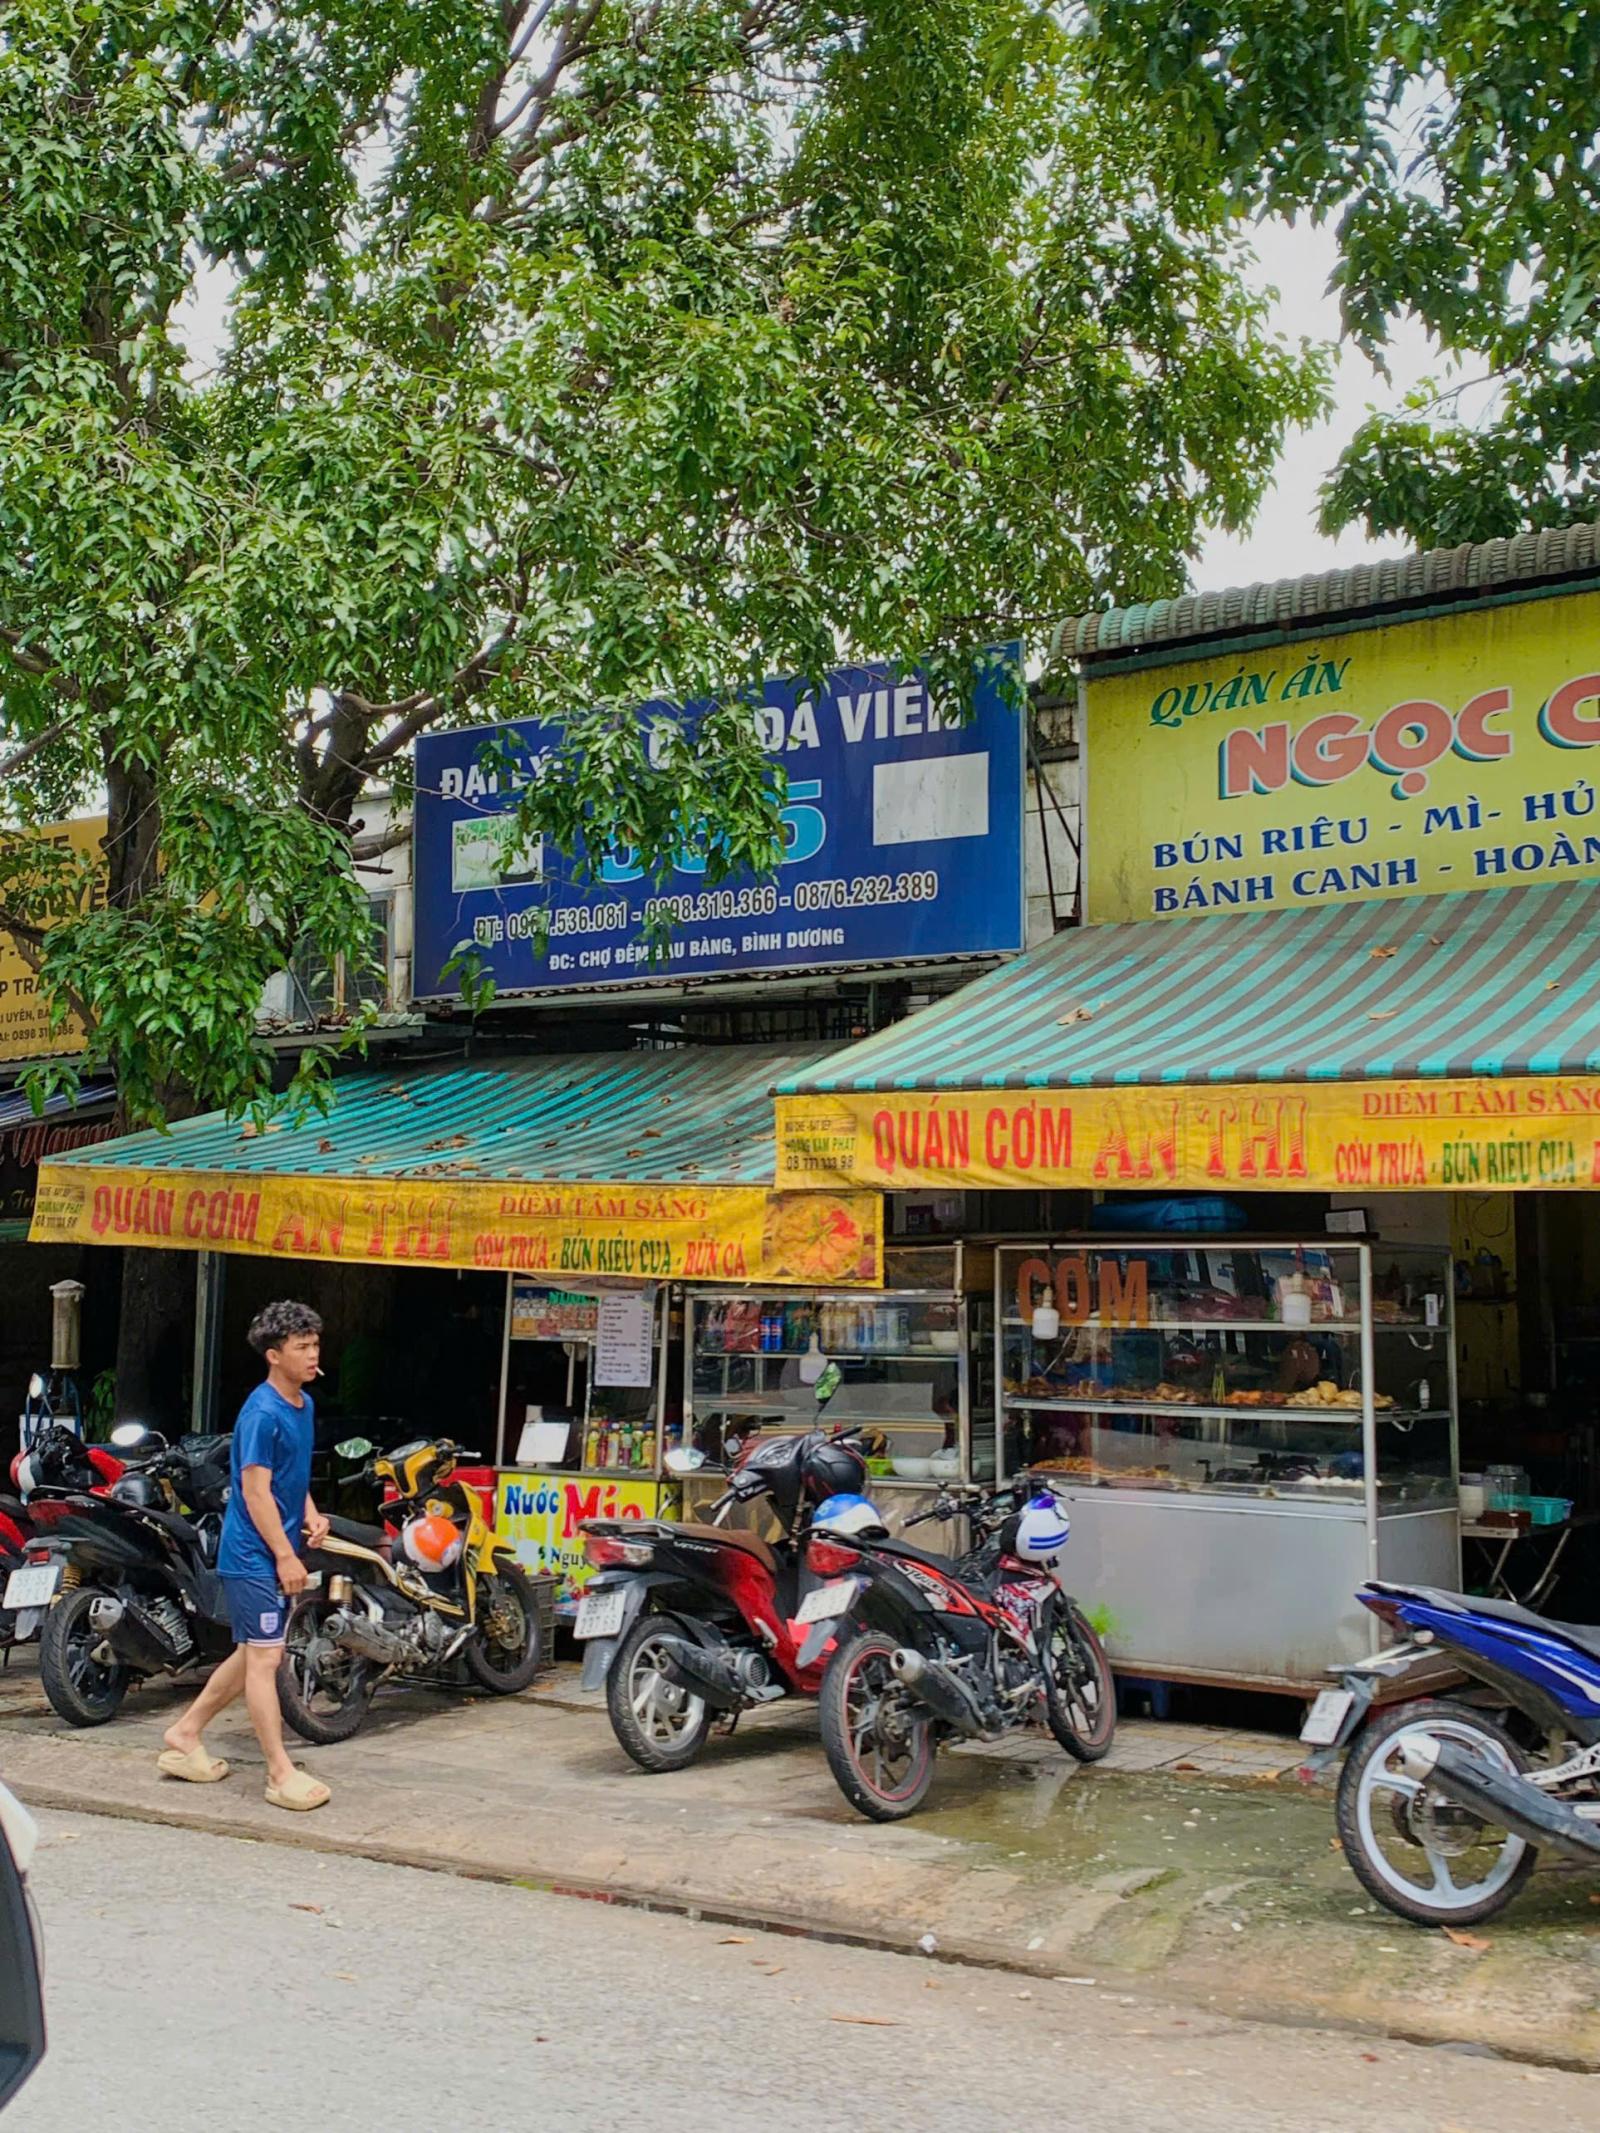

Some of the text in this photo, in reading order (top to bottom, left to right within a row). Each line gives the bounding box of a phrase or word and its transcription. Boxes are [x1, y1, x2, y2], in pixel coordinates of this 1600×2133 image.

[1149, 655, 1352, 727] QUÁN ĂN
[1218, 686, 1512, 799] NGỌC
[1154, 832, 1243, 868] BÚN
[1262, 816, 1368, 855] RIÊU
[1523, 780, 1595, 822] HỦ
[794, 871, 938, 912] 0876.232.389
[1154, 876, 1275, 912] BÁNH
[1292, 858, 1417, 896] CANH
[549, 955, 576, 971] ĐC:
[579, 946, 612, 969] CHỢ
[689, 934, 737, 957] BÀNG,
[742, 930, 781, 953] BÌNH
[787, 927, 845, 949] DƯƠNG
[872, 1095, 970, 1176] QUÁN
[985, 1098, 1072, 1170] CƠM
[1443, 1129, 1480, 1184] BÚN
[92, 1177, 175, 1236] QUÁN
[185, 1184, 261, 1241] CƠM
[560, 1228, 593, 1270] BÚN
[597, 1229, 635, 1273] RIÊU
[640, 1239, 671, 1274] CUA
[722, 1232, 748, 1277] CÁ
[1018, 1249, 1149, 1328] CƠM
[551, 1548, 588, 1570] Nguy
